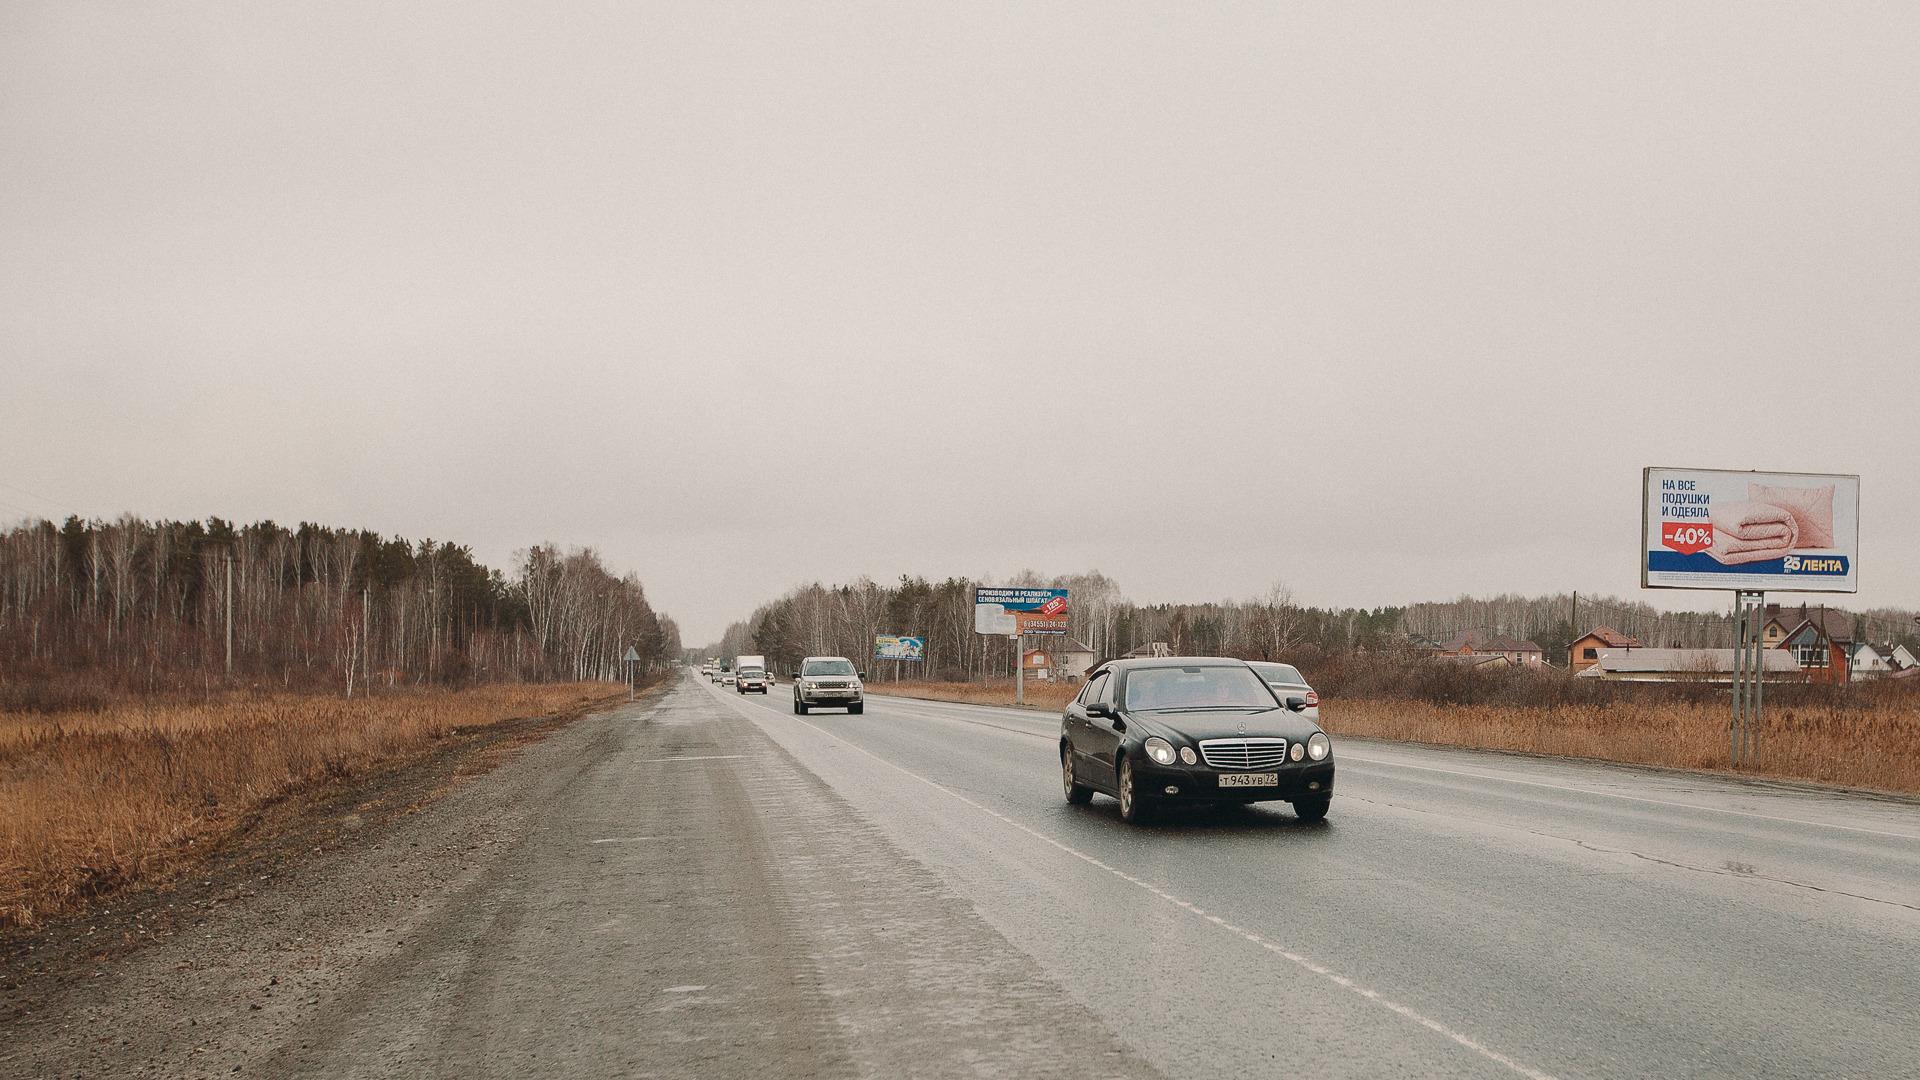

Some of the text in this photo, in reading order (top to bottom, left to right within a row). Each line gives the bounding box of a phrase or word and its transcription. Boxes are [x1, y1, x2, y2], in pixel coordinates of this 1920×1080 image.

[1662, 479, 1696, 491] НА ВСЕ
[1662, 492, 1710, 505] ПОДУШКИ
[1662, 506, 1710, 518] И ОДЕЯЛА
[1664, 527, 1712, 545] -40%
[1783, 555, 1843, 572] 25 ЛЕНТА
[978, 589, 1014, 597] ПРОИЗВОДИМ
[1020, 590, 1052, 598] РЕАЛИЗУЕМ
[978, 596, 1025, 604] СЕНОВЯЗАЛЬНЫЙ
[1265, 774, 1275, 782] 72
